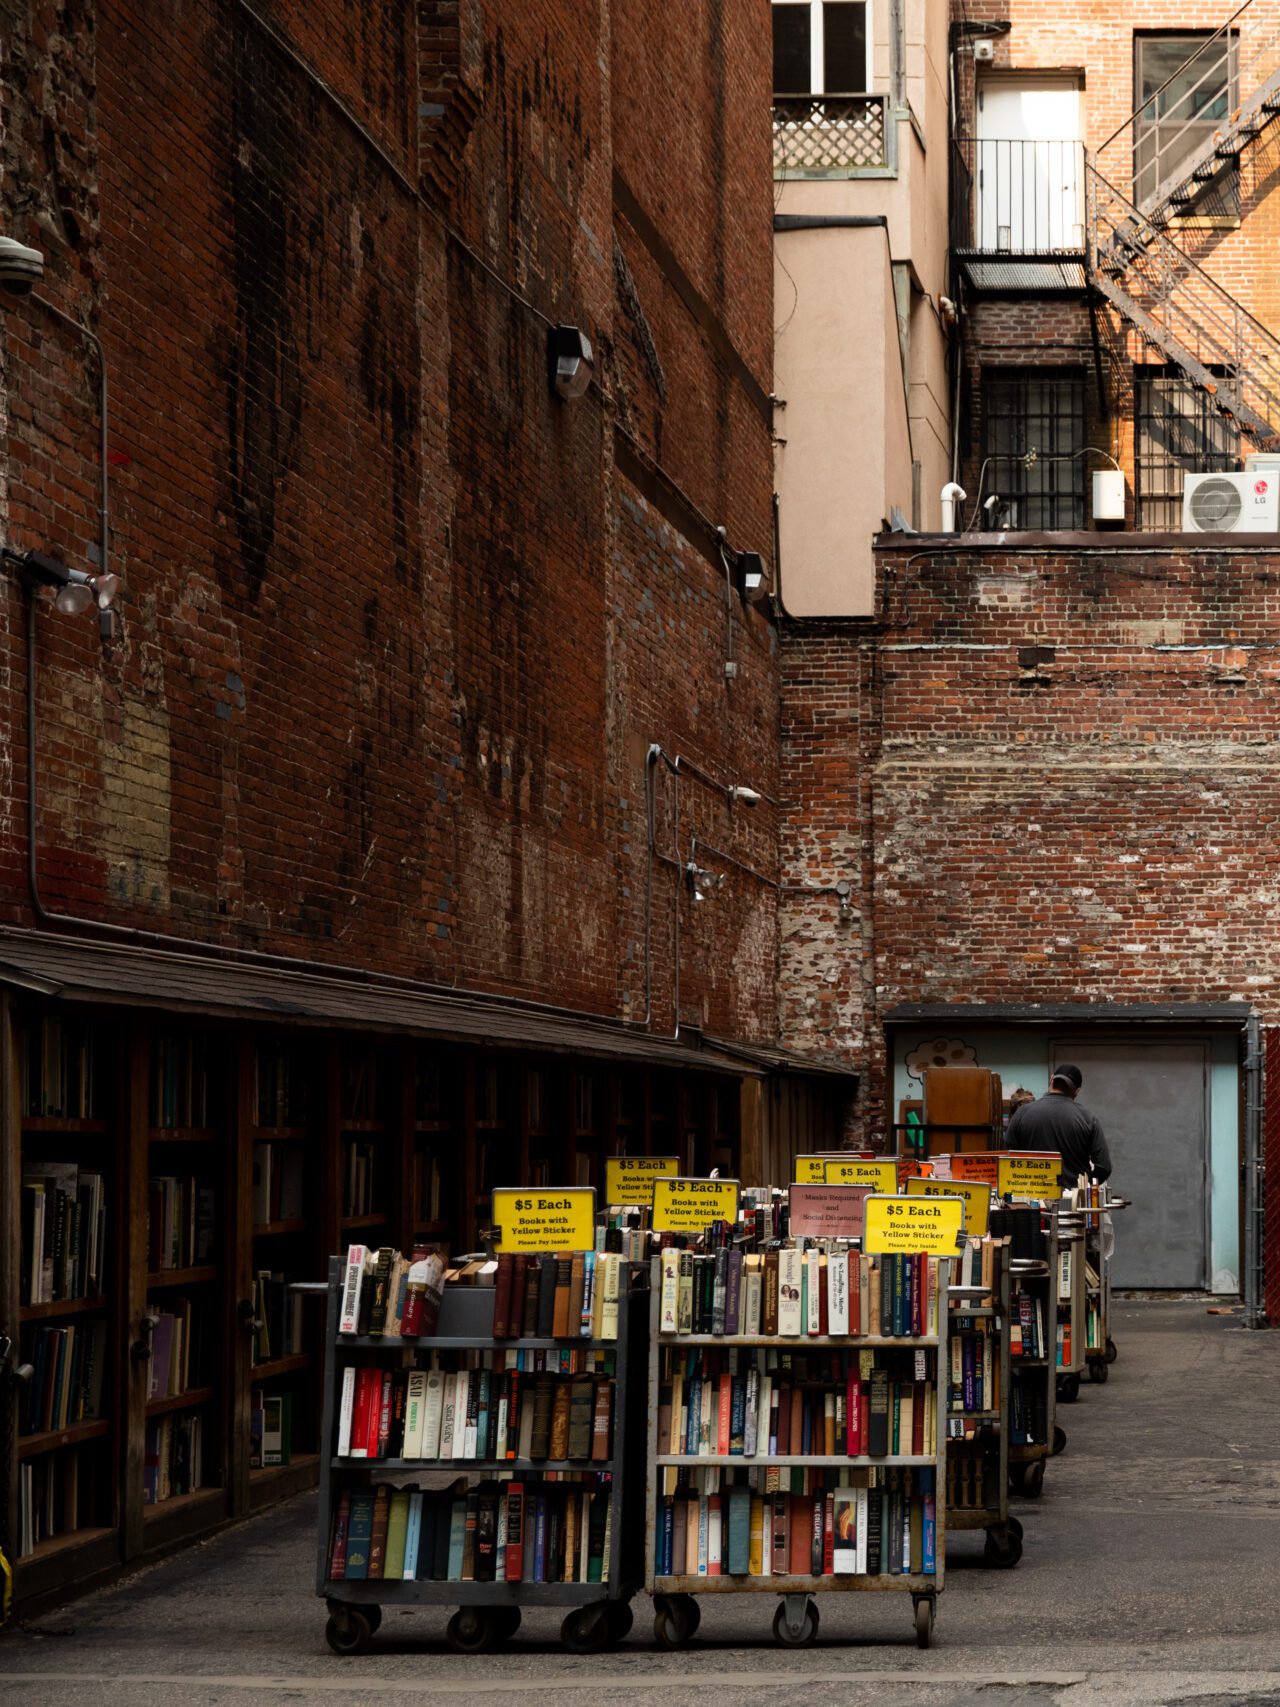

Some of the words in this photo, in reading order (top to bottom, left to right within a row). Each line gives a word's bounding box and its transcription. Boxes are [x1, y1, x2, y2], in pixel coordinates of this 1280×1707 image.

[620, 1160, 634, 1170] $5
[638, 1160, 666, 1170] Each
[809, 1162, 820, 1170] $5
[1010, 1160, 1022, 1168] $5
[1026, 1160, 1051, 1169] Each
[840, 1168, 853, 1176] $5
[856, 1168, 882, 1176] Each
[668, 1182, 686, 1193] $5
[689, 1182, 723, 1193] Each
[924, 1186, 940, 1196] $5
[944, 1188, 972, 1200] Each
[830, 1194, 860, 1202] Required
[515, 1200, 532, 1210] $5
[537, 1200, 572, 1210] Each
[886, 1205, 904, 1217] $5
[908, 1206, 942, 1217] Each
[664, 1208, 692, 1216] Yellow
[694, 1209, 726, 1217] Sticker
[802, 1214, 824, 1222] Social
[826, 1214, 863, 1223] Distancing
[519, 1217, 543, 1225] Books
[545, 1216, 568, 1224] with
[890, 1222, 914, 1230] Books
[916, 1222, 937, 1230] with
[512, 1227, 540, 1236] Yellow
[543, 1226, 576, 1234] Sticker
[882, 1230, 911, 1240] Yellow
[913, 1231, 944, 1240] Sticker
[786, 1252, 796, 1283] Dreadnought
[348, 1266, 358, 1290] OPERATION
[609, 1274, 618, 1294] BOWDEN
[345, 1292, 356, 1316] DRUMBEAT
[1019, 1300, 1032, 1326] 1967
[410, 1374, 423, 1396] ASAD
[396, 1386, 404, 1419] Pakistan
[446, 1404, 454, 1422] Saudi
[732, 1406, 740, 1433] NAMES
[444, 1422, 452, 1444] Arabia
[698, 1512, 706, 1529] Viking
[698, 1530, 706, 1548] Legacy
